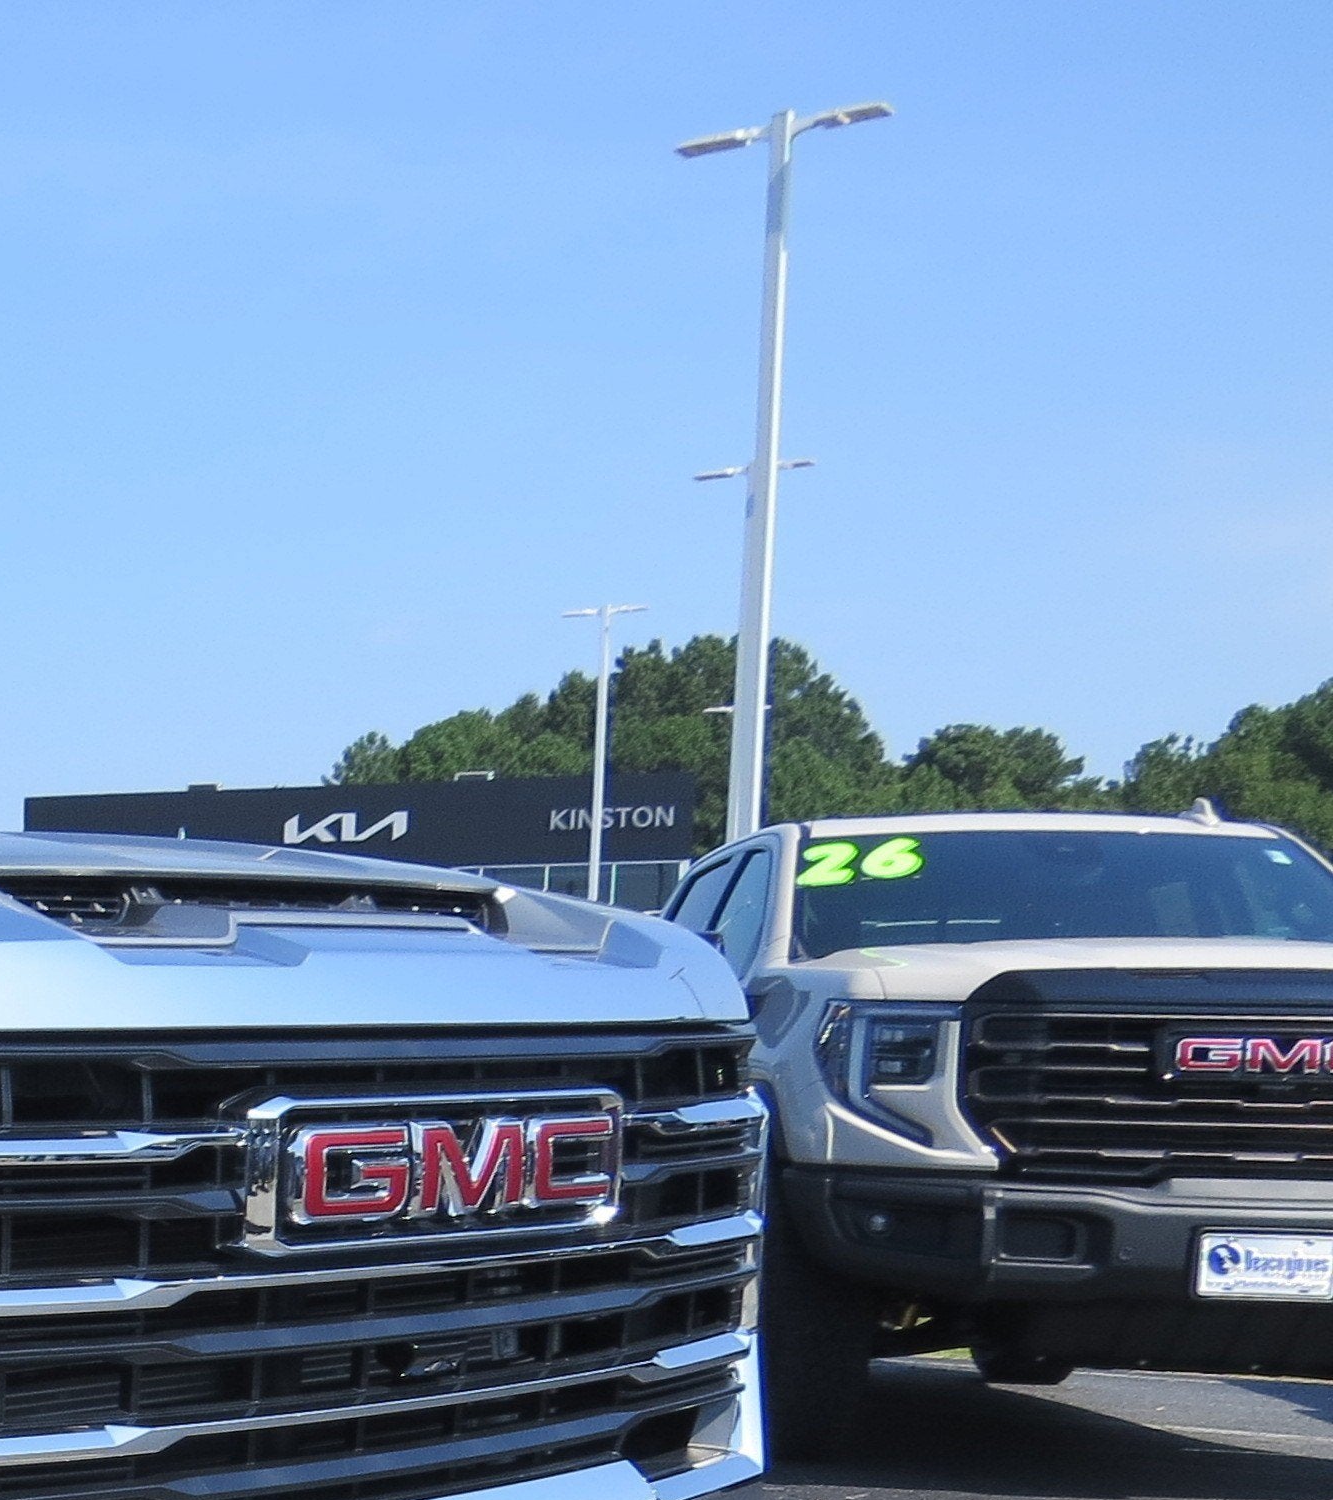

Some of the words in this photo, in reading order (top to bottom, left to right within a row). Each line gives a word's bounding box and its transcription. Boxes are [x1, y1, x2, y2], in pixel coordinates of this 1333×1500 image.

[284, 810, 409, 844] KIA
[549, 805, 675, 830] KINSTON
[796, 837, 924, 887] 26
[1176, 1038, 1333, 1075] GM
[295, 1115, 613, 1220] GMC
